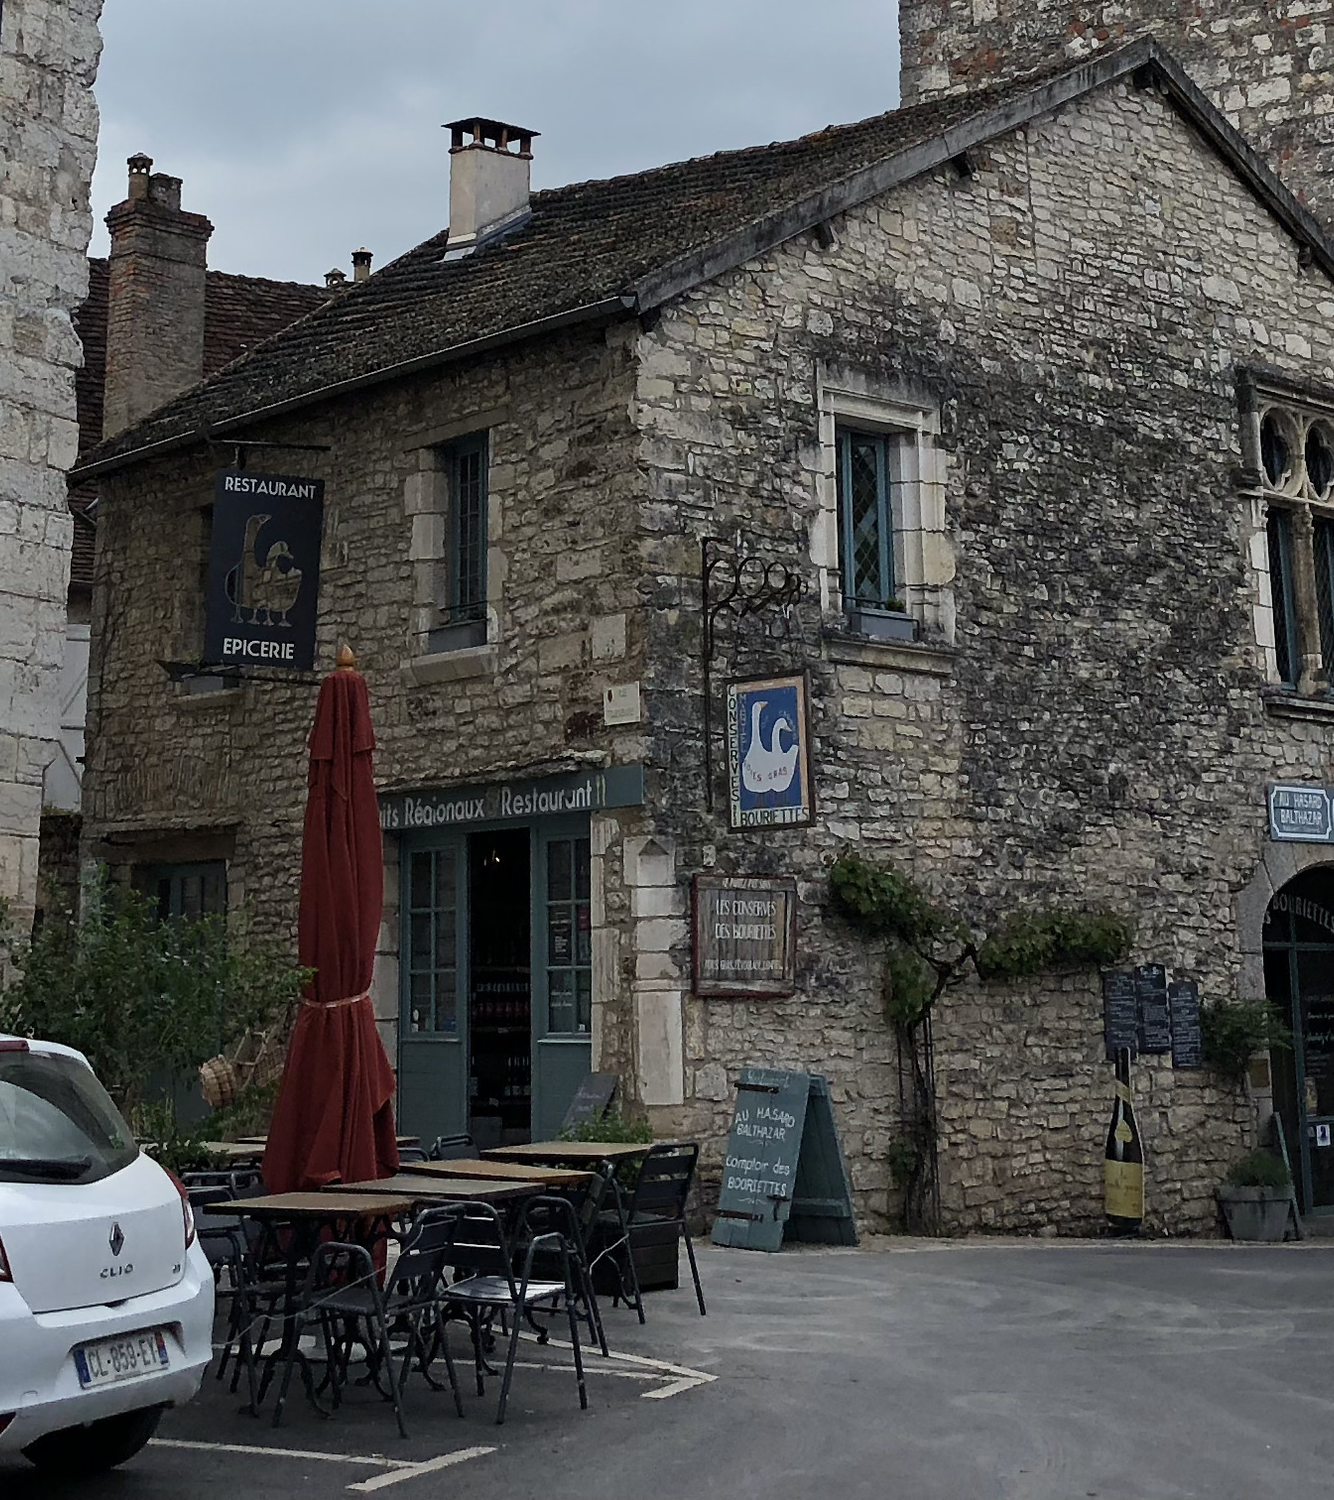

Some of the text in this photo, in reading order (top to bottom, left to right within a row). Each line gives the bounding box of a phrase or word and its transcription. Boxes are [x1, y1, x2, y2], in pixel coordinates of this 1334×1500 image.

[224, 476, 317, 500] RESTAURANT
[222, 637, 295, 660] EPICERIE
[728, 685, 740, 802] CONSERVES
[404, 796, 485, 827] Régionaux
[501, 780, 593, 817] Restaurant
[1293, 793, 1323, 810] HASARD
[740, 807, 809, 828] BOURIETTES
[1280, 809, 1323, 828] BALTHAZAR
[716, 899, 777, 917] LES CONSERVES
[715, 923, 777, 940] DES BOURIETTES
[735, 1107, 796, 1128] AU HASARD
[736, 1123, 786, 1141] BALTHAZAR
[727, 1176, 787, 1197] BOURIETTES
[100, 1263, 134, 1278] CLIO
